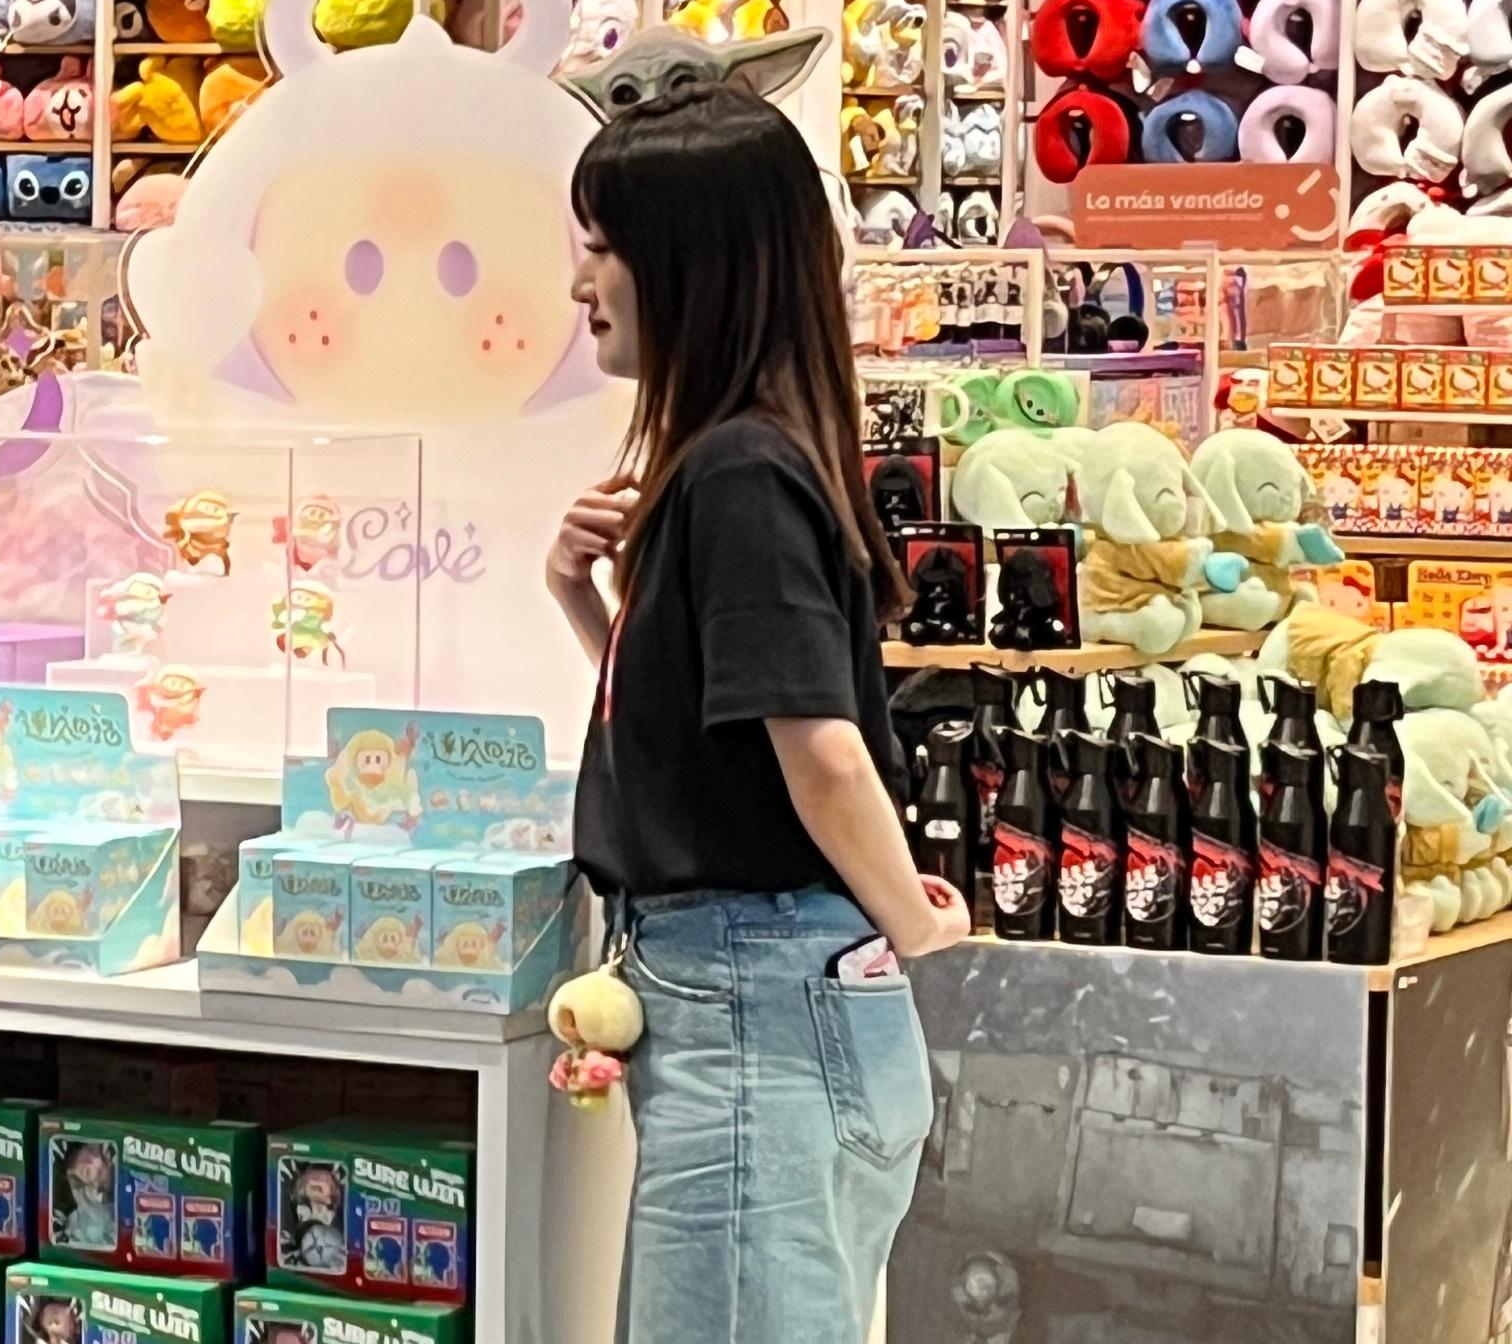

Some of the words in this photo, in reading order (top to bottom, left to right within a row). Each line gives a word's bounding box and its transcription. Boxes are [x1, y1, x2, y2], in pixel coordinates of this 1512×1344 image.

[1086, 193, 1110, 209] Lo
[1115, 191, 1164, 209] más
[1170, 189, 1264, 210] vendido
[353, 1158, 410, 1192] SURE
